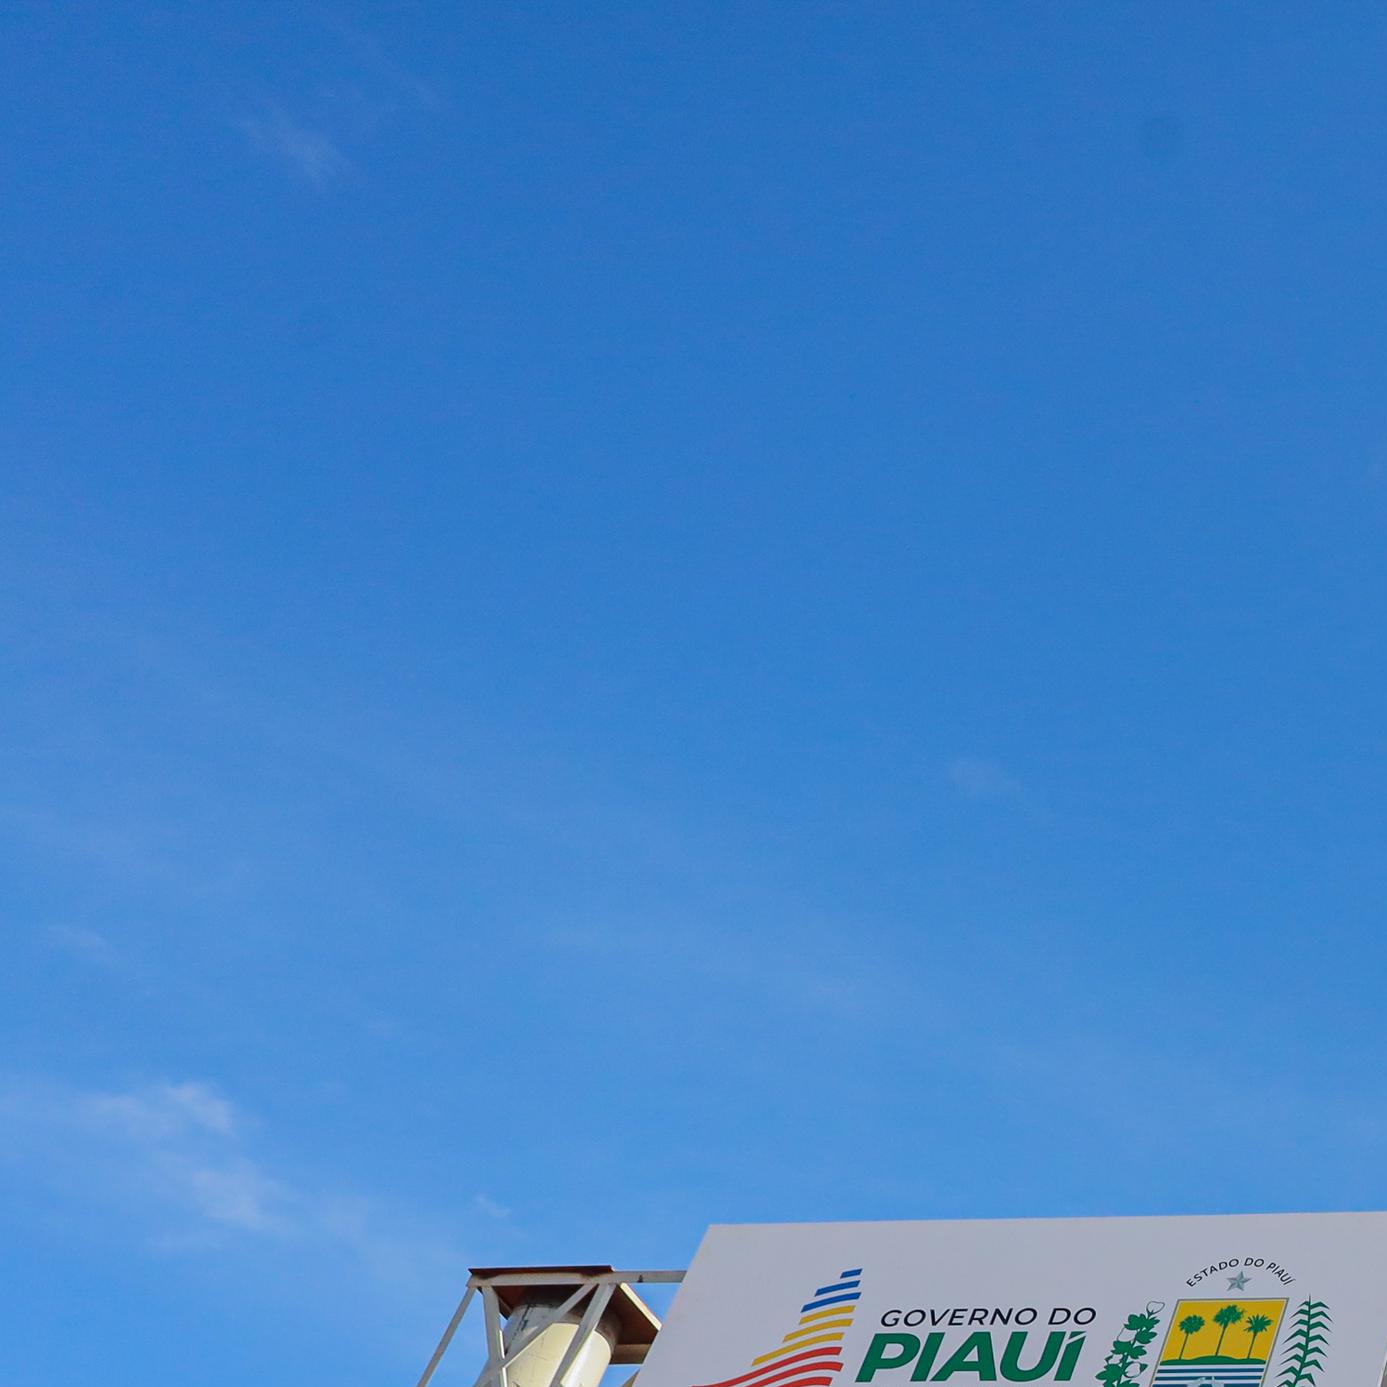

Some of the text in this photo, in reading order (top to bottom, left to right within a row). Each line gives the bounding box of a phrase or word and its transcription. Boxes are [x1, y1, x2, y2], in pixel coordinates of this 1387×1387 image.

[1186, 1257, 1296, 1287] ESTADO DO PIAUÍ
[881, 1307, 1097, 1327] GOVERNO DO
[855, 1331, 1086, 1382] PIAUÍ
